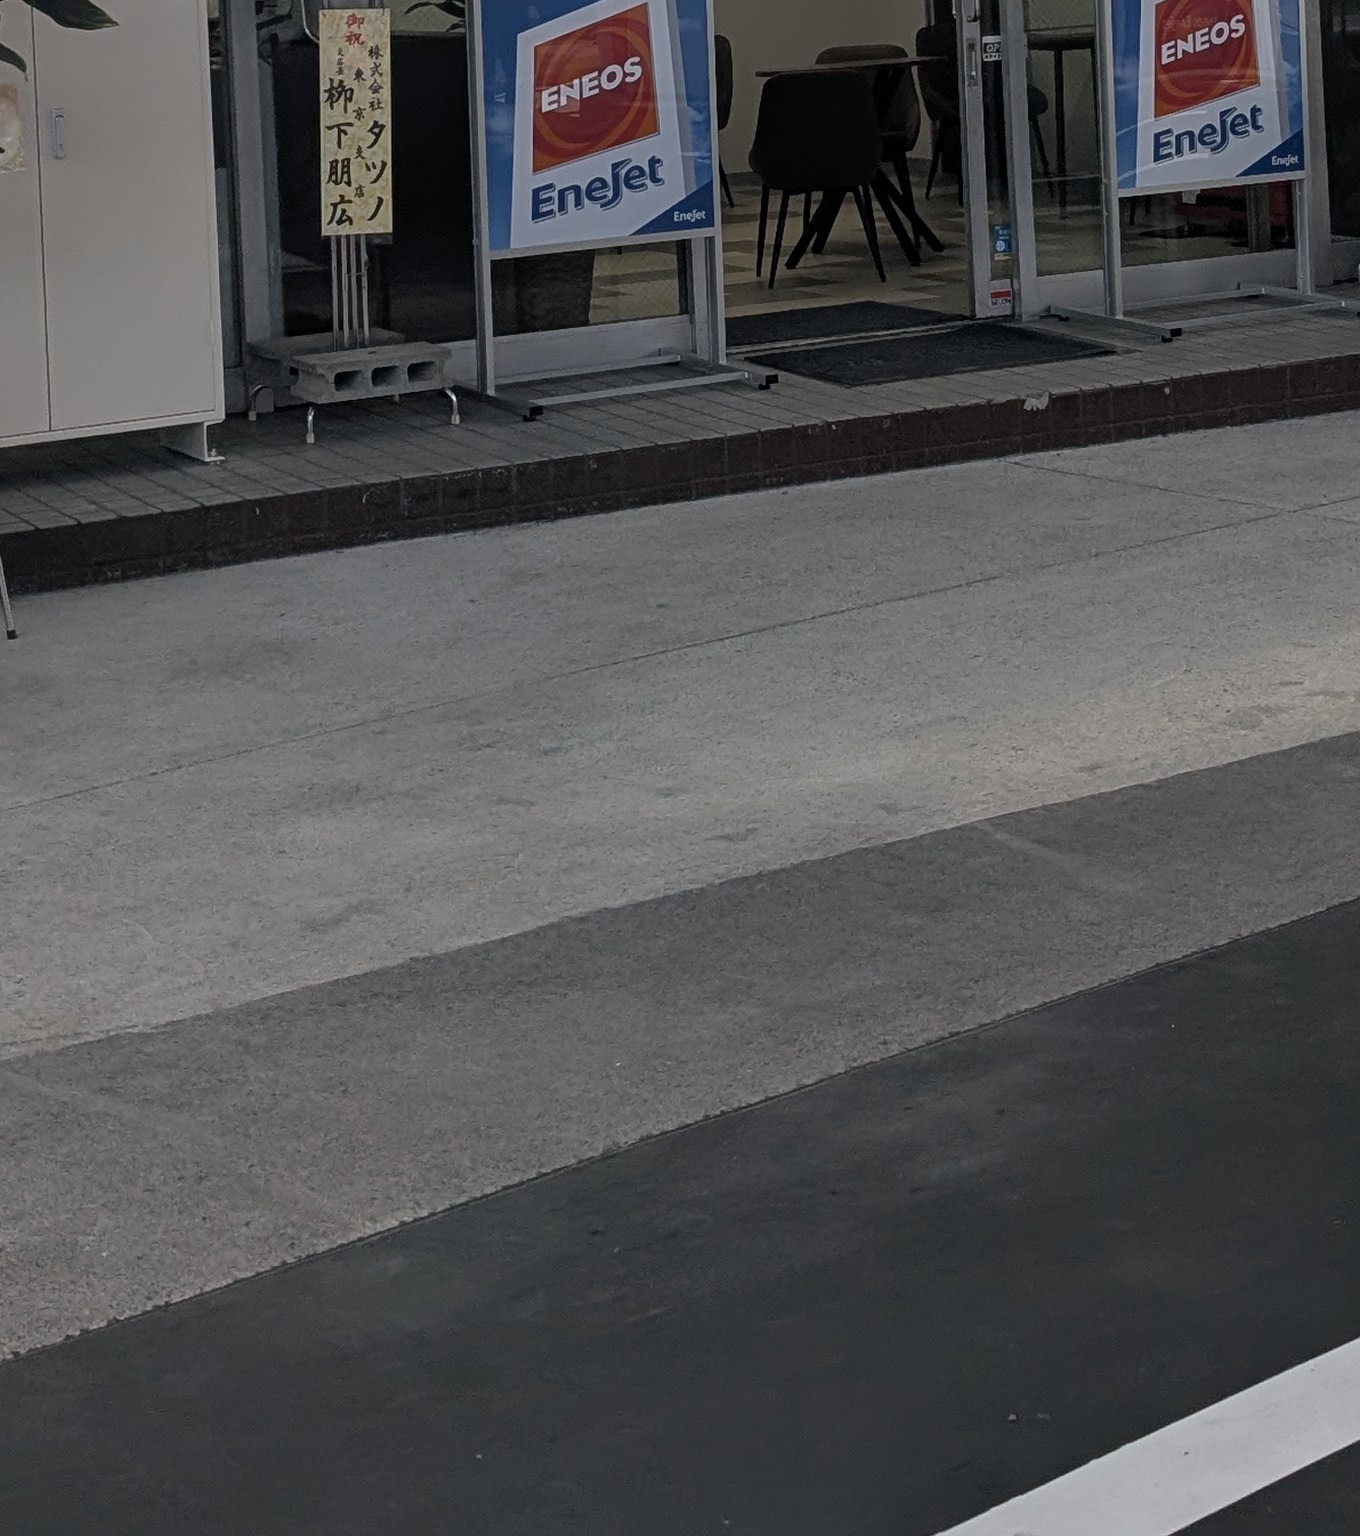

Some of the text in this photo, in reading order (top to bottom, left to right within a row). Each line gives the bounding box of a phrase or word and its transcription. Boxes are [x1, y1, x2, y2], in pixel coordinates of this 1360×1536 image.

[345, 13, 365, 46] 御祝
[1161, 14, 1246, 66] ENEOS
[541, 55, 643, 114] ENEOS
[1152, 104, 1265, 165] EneJet
[1271, 154, 1299, 166] EneJet
[531, 155, 665, 224] EneJet
[673, 210, 706, 222] EneJet
